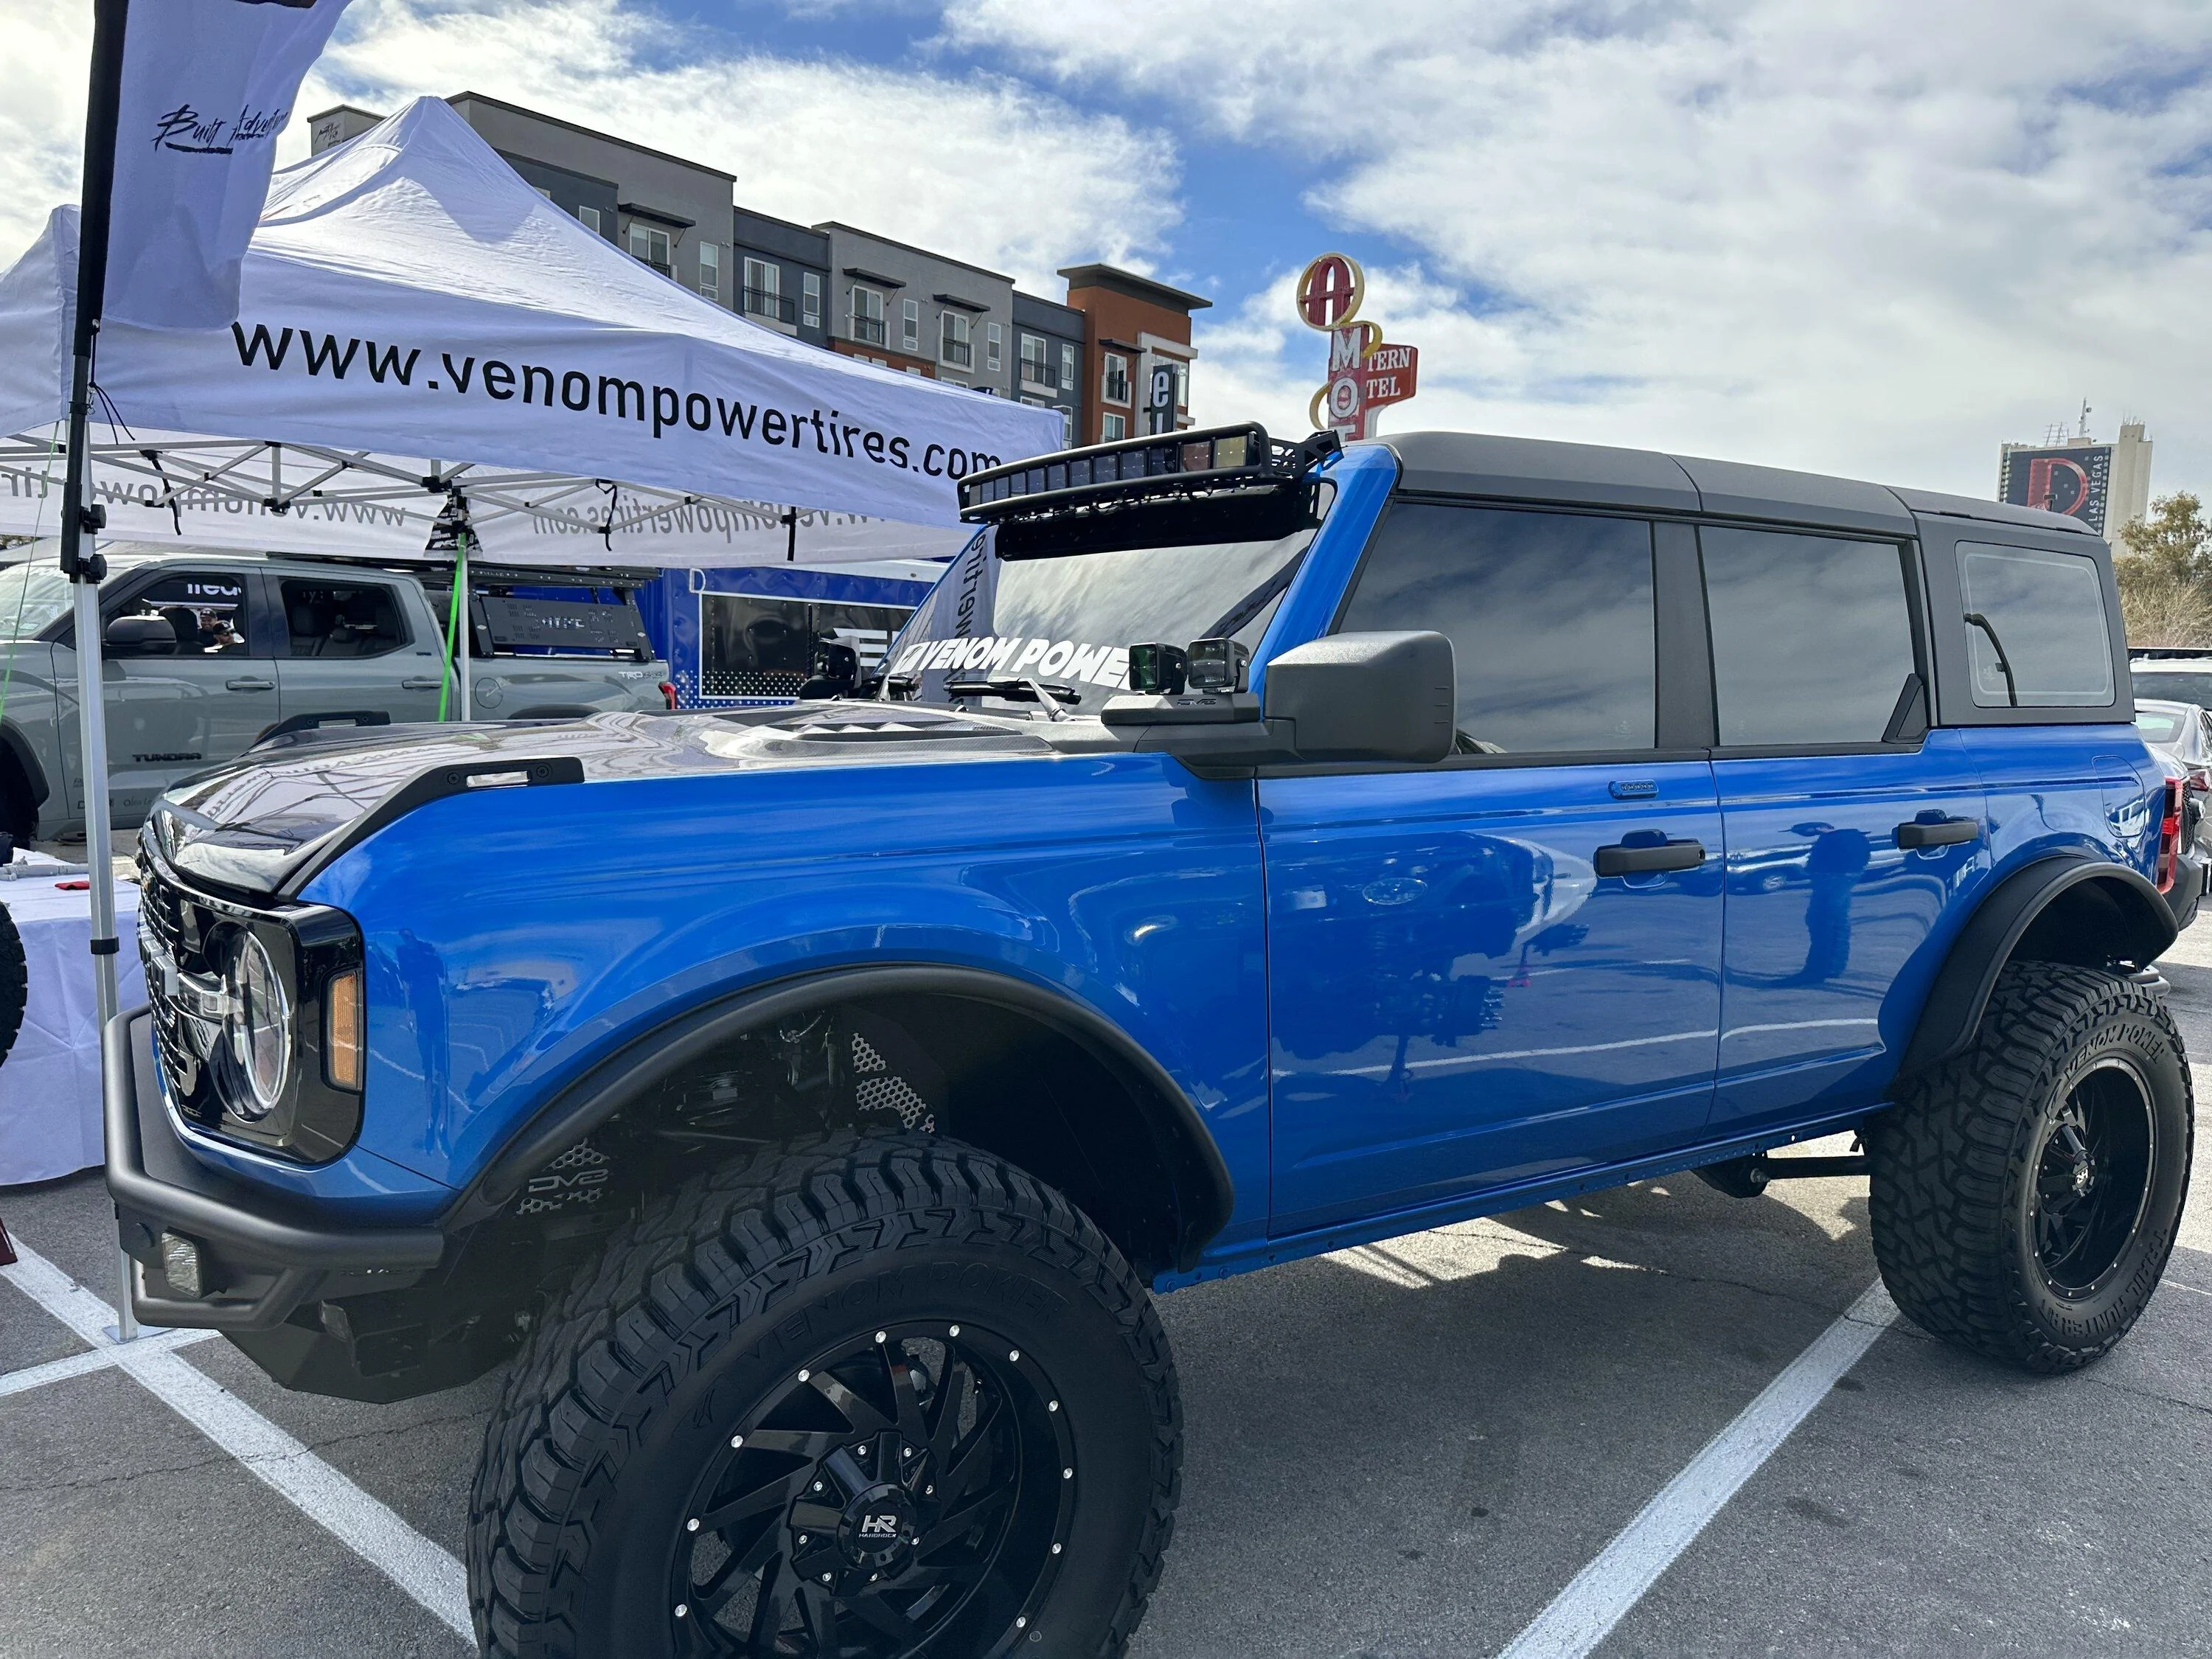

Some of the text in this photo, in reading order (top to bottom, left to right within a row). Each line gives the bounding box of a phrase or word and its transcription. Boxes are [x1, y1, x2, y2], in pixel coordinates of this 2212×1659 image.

[231, 321, 1001, 480] www.venompowertires.com
[2088, 455, 2104, 522] LAS VEGAS
[917, 636, 1023, 672] VENOM
[1010, 638, 1131, 690] POWE
[133, 752, 202, 762] TUNDRA
[861, 1514, 897, 1532] HR
